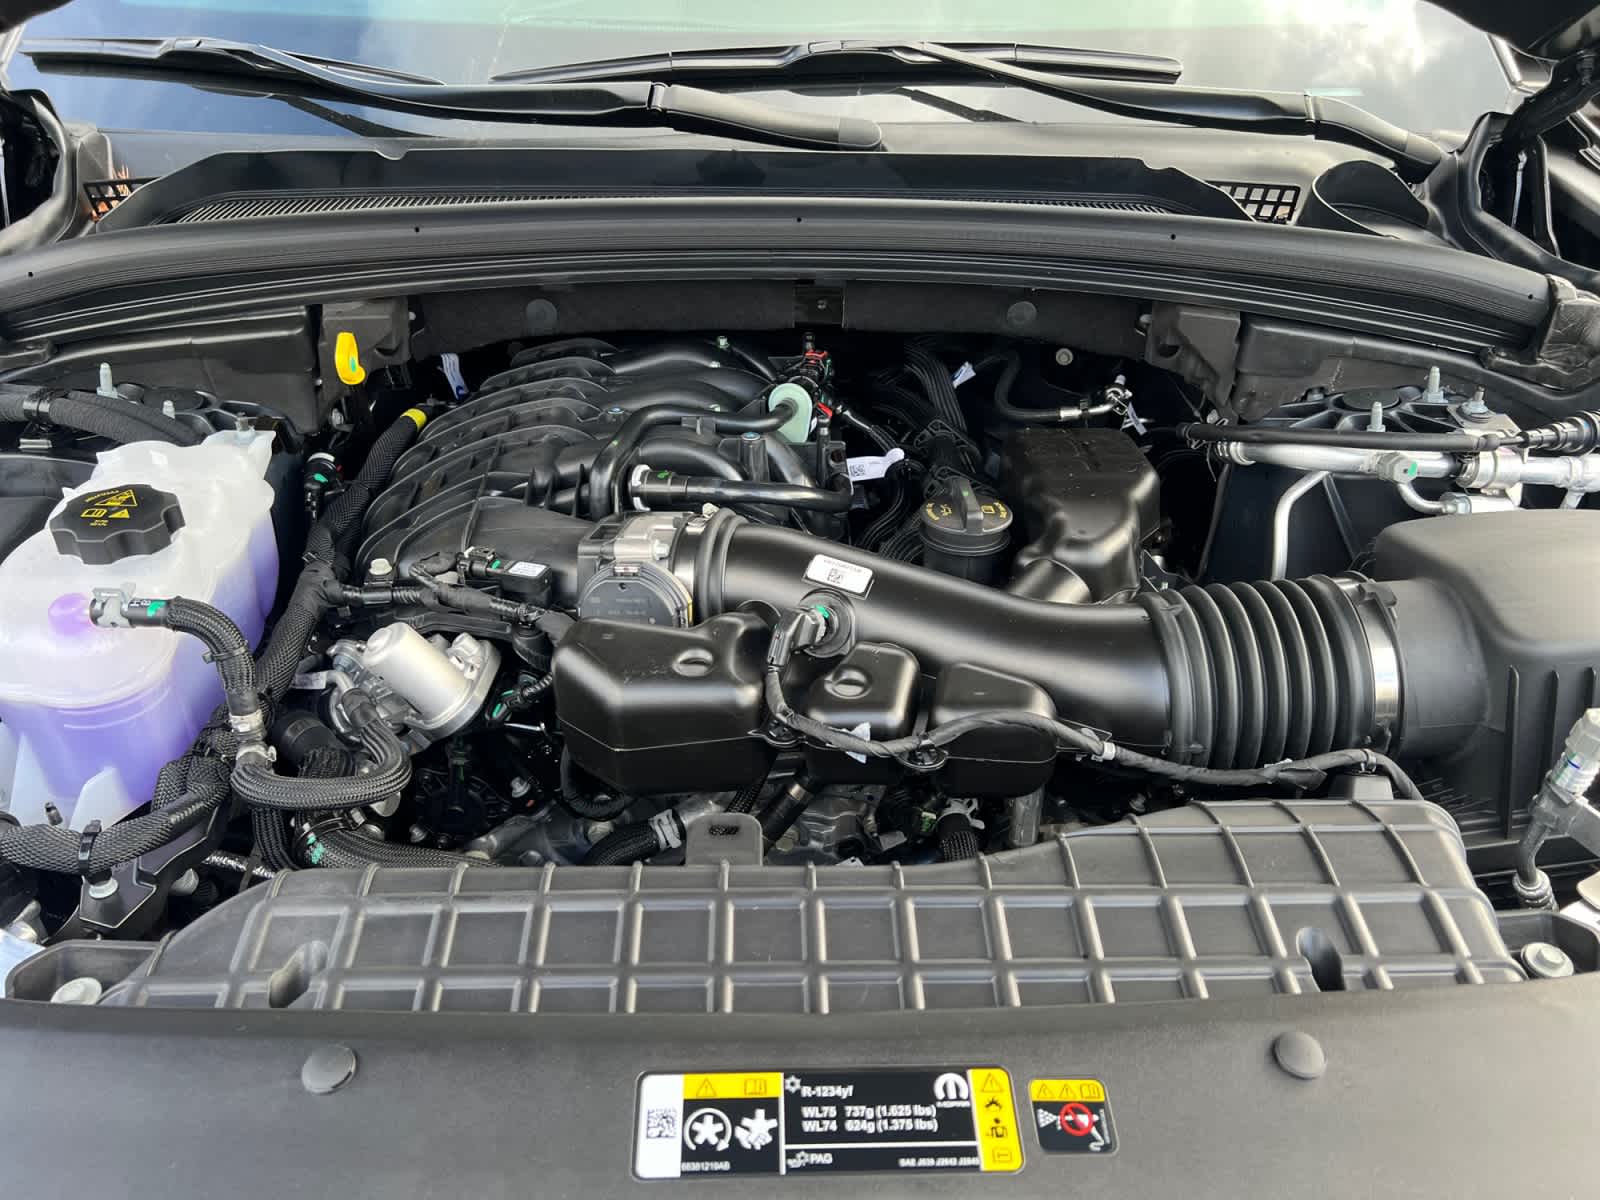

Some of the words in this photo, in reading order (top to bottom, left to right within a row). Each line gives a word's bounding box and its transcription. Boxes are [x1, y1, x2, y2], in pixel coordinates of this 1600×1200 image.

[801, 1085, 853, 1099] R-1234yf
[801, 1106, 837, 1118] WL75
[844, 1105, 874, 1119] 737g
[913, 1104, 937, 1118] lbs)
[802, 1120, 838, 1132] WL74
[845, 1120, 875, 1133] 624g
[876, 1119, 913, 1132] (1.375
[914, 1118, 939, 1132] lbs)
